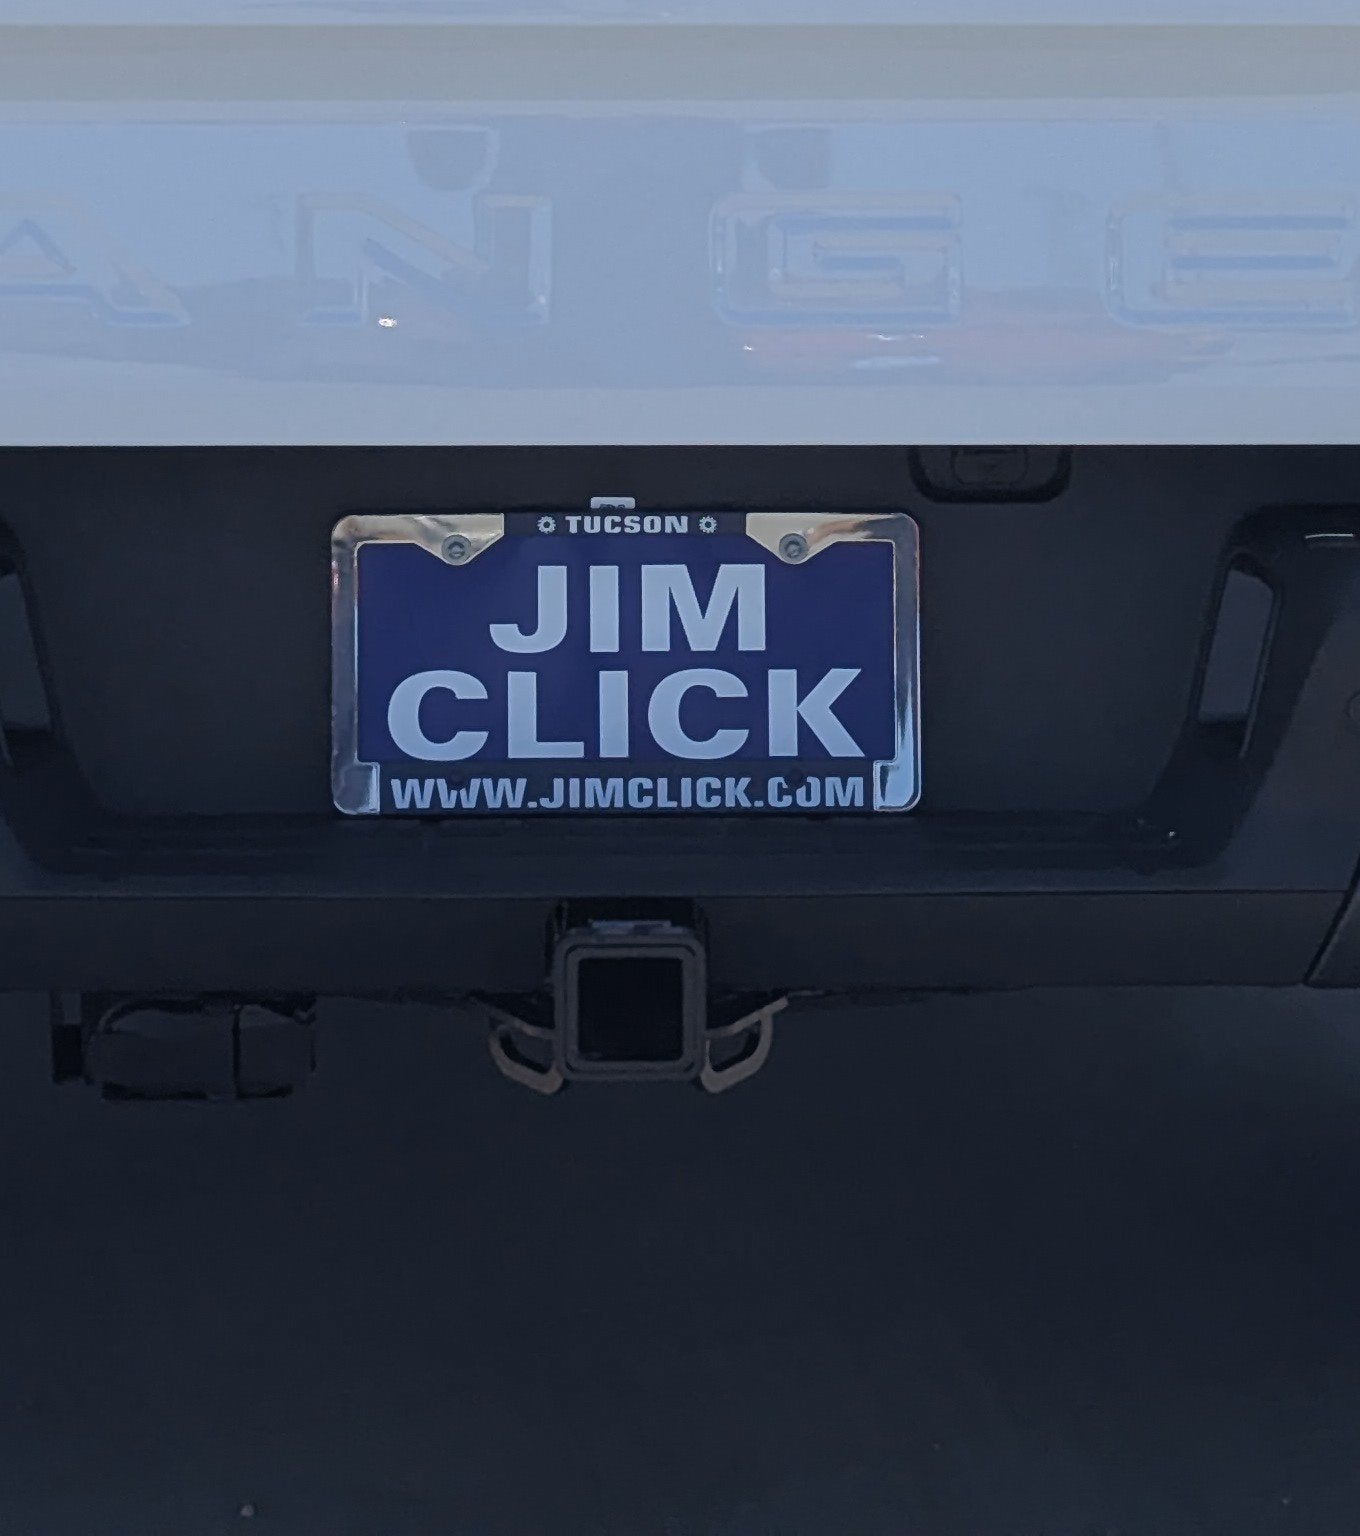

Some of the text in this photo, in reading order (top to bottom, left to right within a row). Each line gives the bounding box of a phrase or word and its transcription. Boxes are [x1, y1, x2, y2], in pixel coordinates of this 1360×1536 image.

[565, 515, 689, 535] TUCSON
[489, 563, 767, 654] JIM
[387, 668, 865, 760] CLICK
[391, 776, 865, 809] WWW.JIMCLICK.COM
